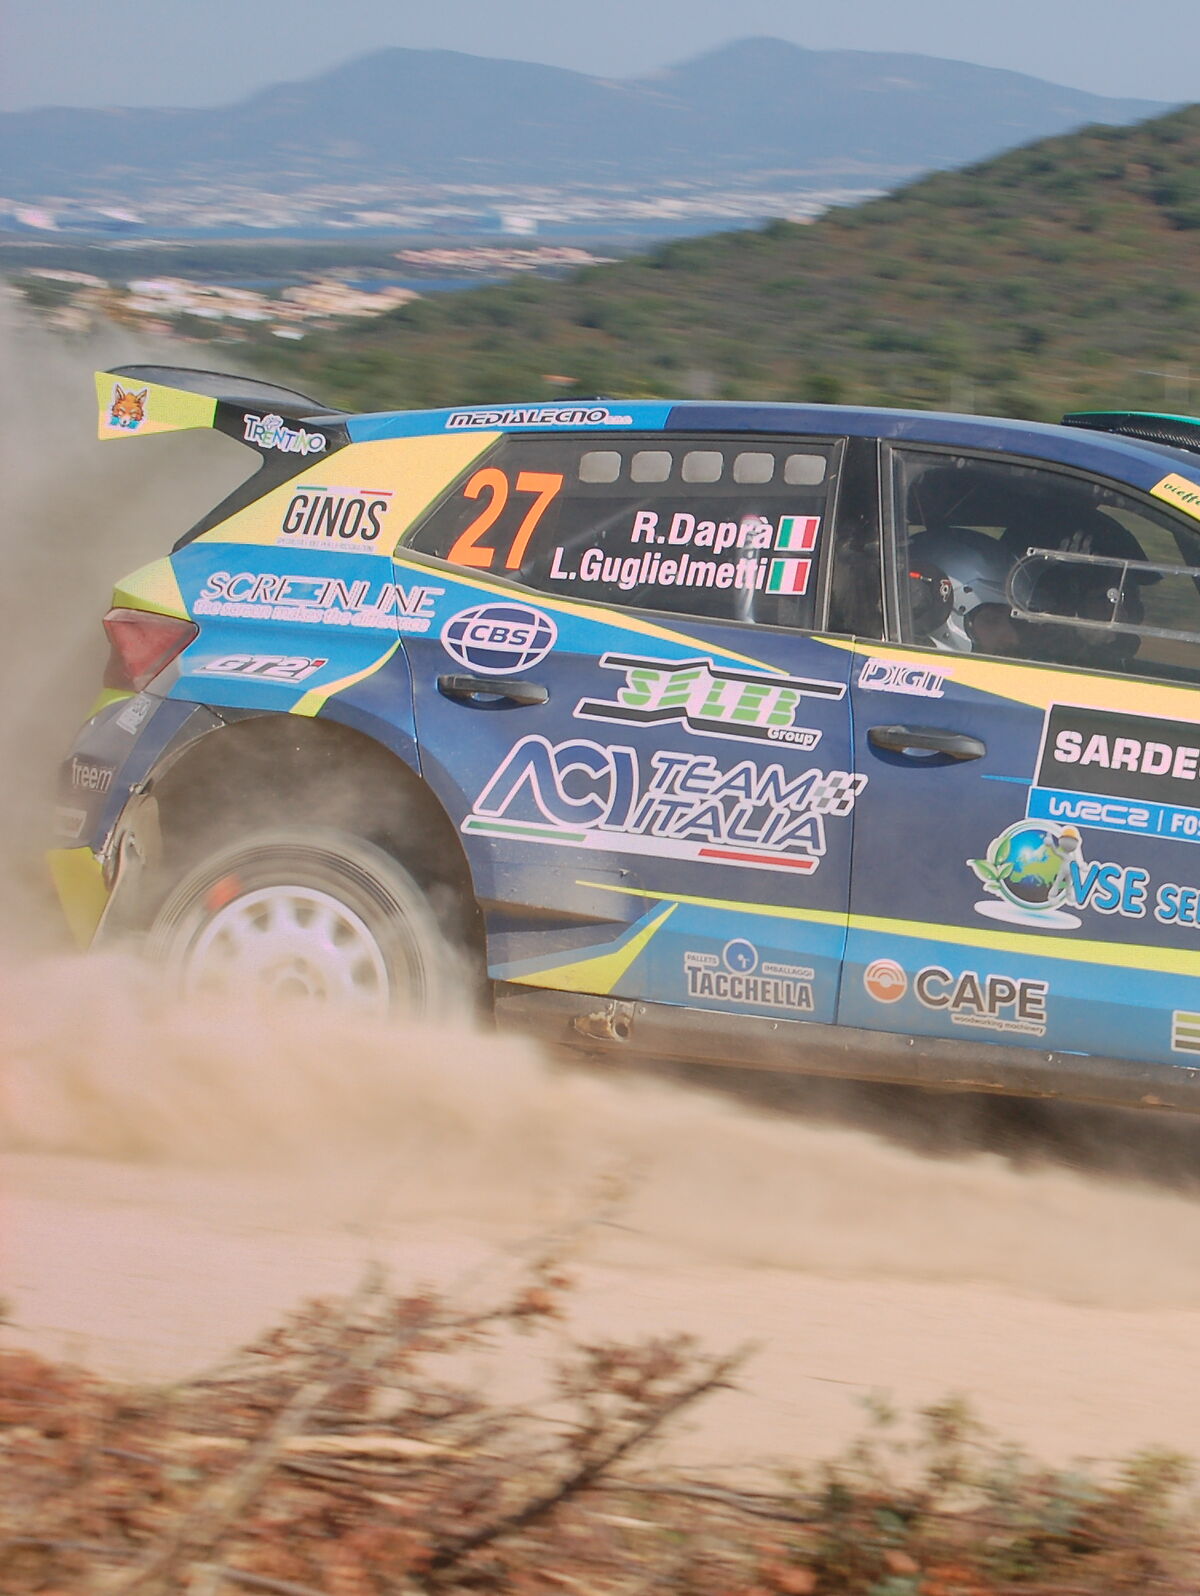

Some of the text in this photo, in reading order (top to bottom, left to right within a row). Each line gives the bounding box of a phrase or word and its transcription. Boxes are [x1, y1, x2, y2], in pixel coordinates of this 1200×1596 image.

[246, 416, 324, 452] TRENTINO
[282, 494, 388, 541] GINOS
[445, 468, 565, 571] 27
[631, 510, 775, 554] R.Daprà
[550, 547, 769, 591] L.Guglielmetti
[469, 623, 531, 647] CBS
[767, 727, 815, 746] Group
[475, 735, 638, 829] ACI
[653, 754, 820, 811] TEAM
[634, 798, 823, 853] ITALIA
[1048, 796, 1150, 828] WRC2
[1069, 860, 1147, 914] VSE
[687, 965, 812, 1009] TACCHELLA
[917, 968, 1046, 1021] CAPE
[953, 1015, 1045, 1035] woodworking machinery
